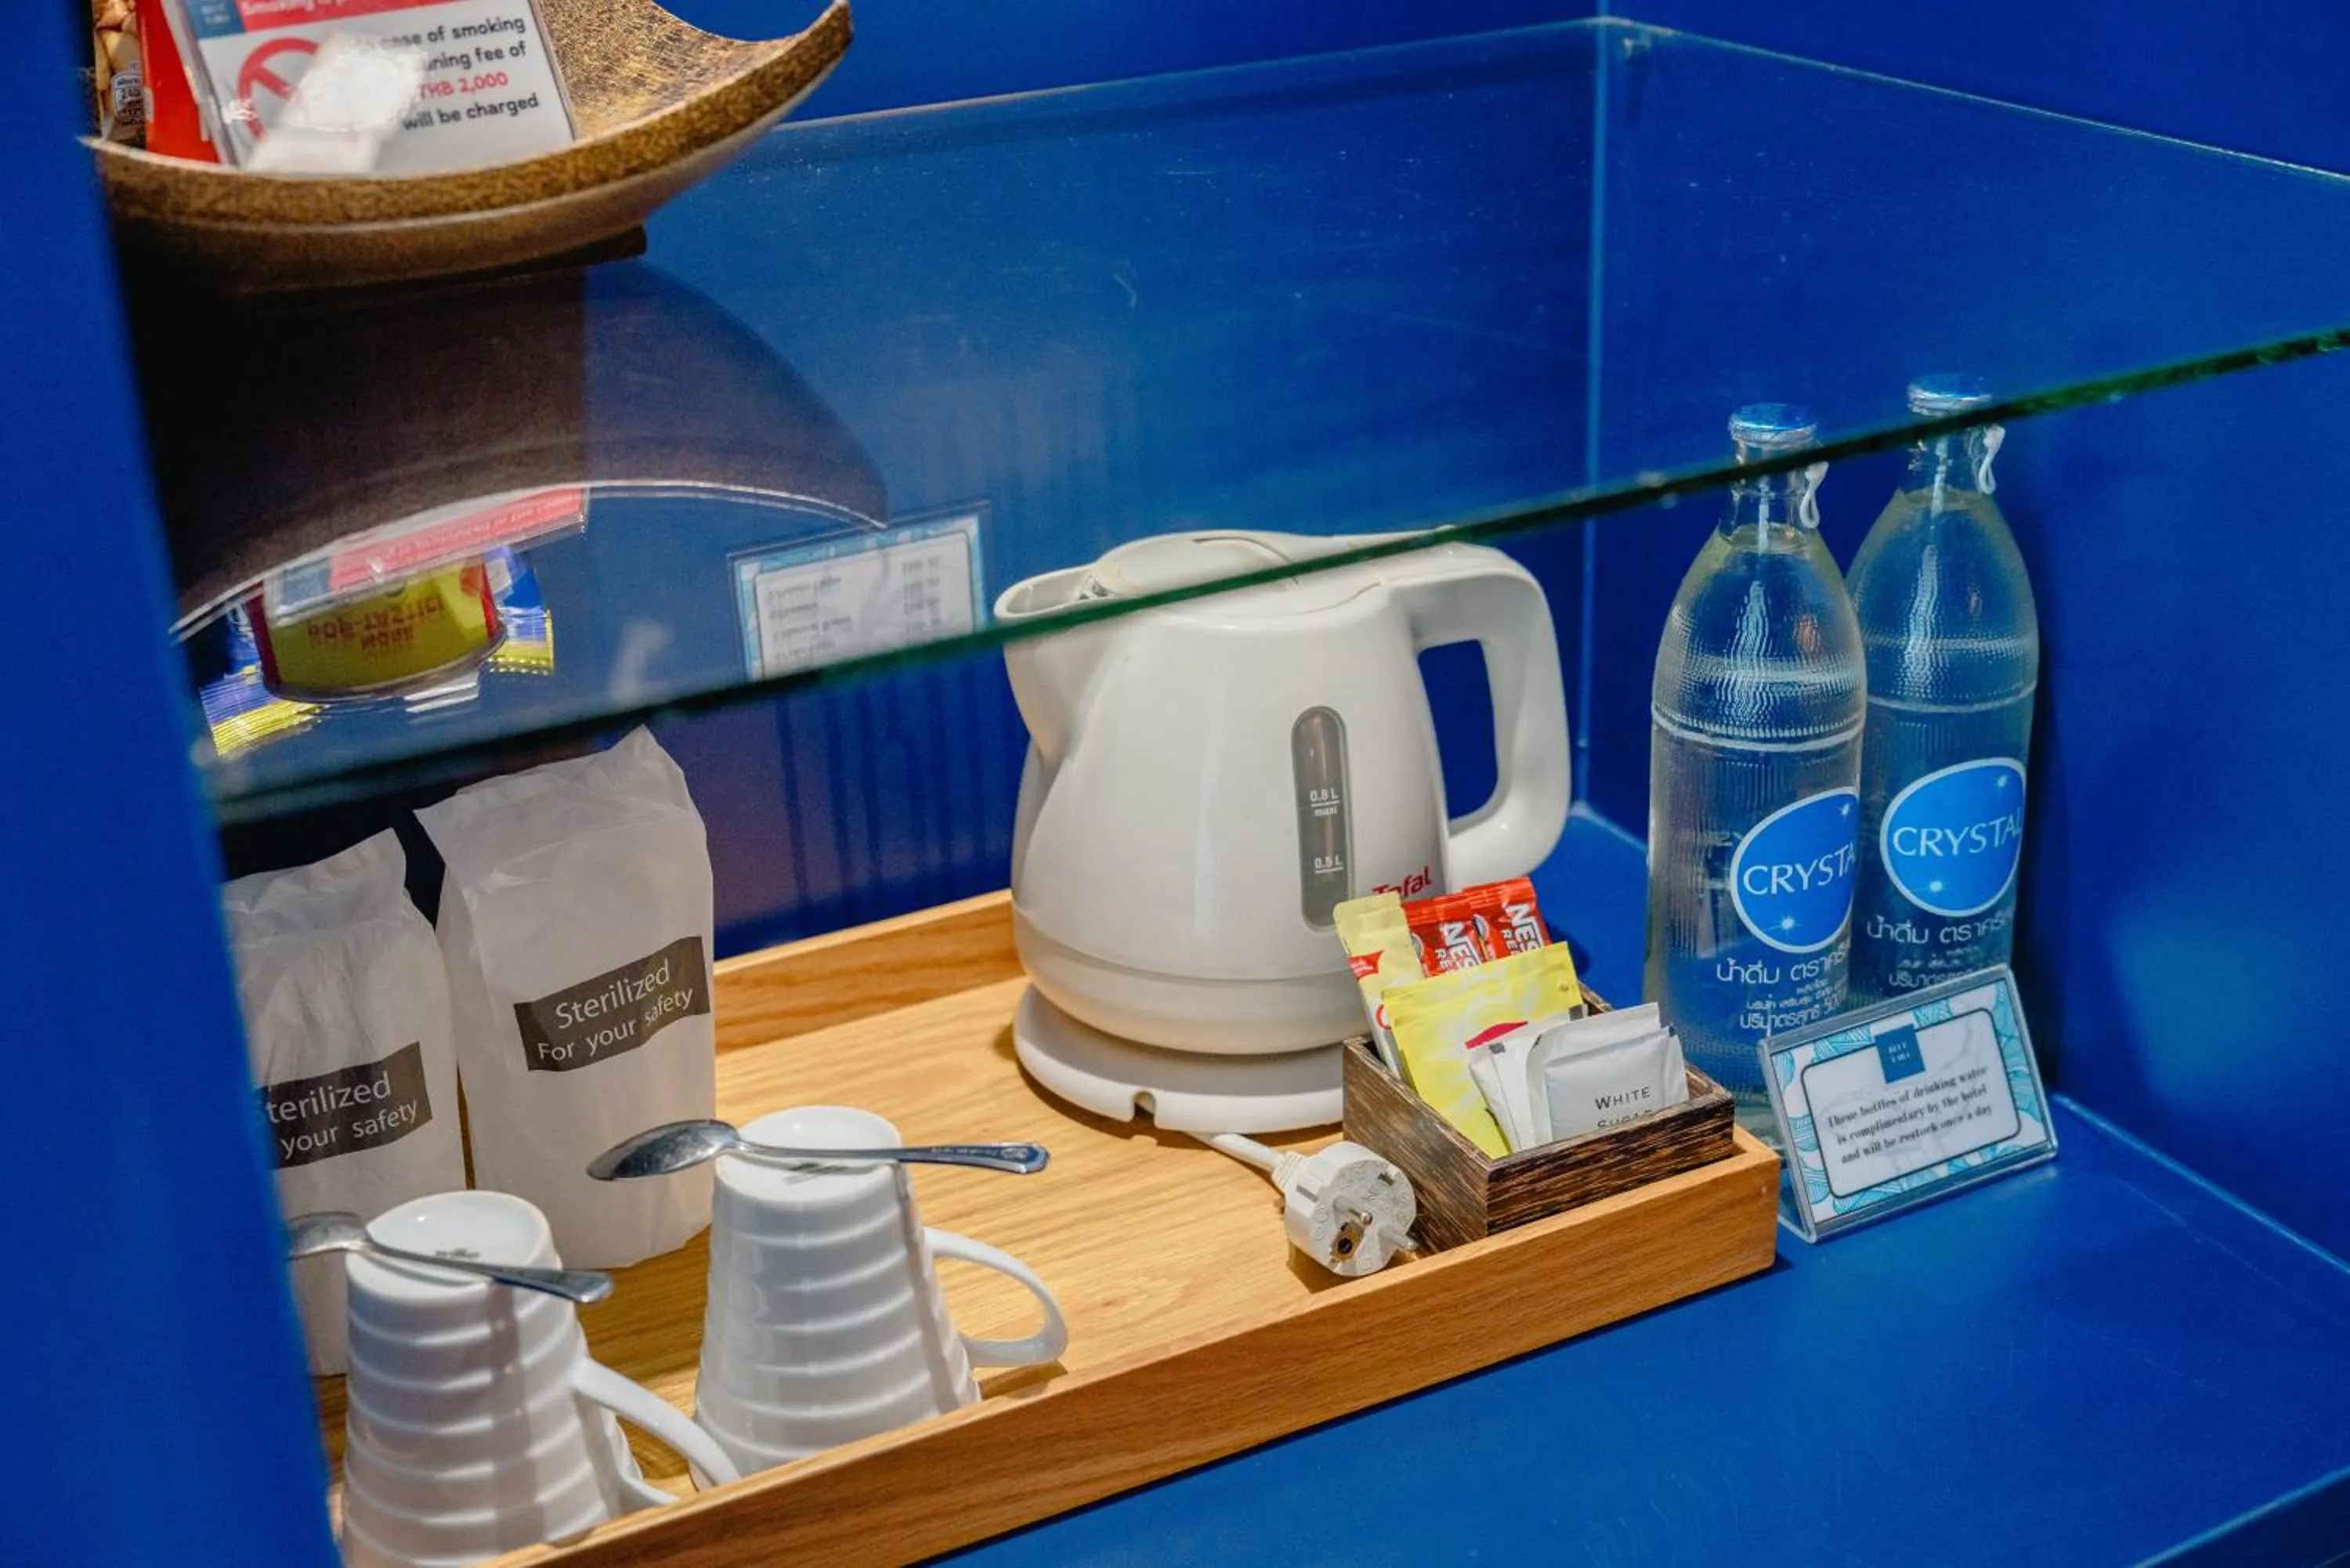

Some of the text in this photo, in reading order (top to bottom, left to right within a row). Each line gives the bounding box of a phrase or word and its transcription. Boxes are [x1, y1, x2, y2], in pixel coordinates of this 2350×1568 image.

[427, 26, 445, 42] of
[452, 16, 526, 39] smoking
[475, 47, 505, 63] fee
[509, 41, 526, 56] of
[402, 92, 539, 130] will be charged
[419, 72, 509, 100] THB 2,000
[1331, 787, 1339, 800] L
[1335, 854, 1343, 865] L
[1743, 840, 1856, 895] CRYSTA
[555, 957, 671, 1029] Sterilized
[537, 988, 694, 1061] For your safety
[266, 1071, 391, 1123] terilized
[1594, 1086, 1651, 1110] WHITE
[1828, 1066, 1987, 1128] These bottles of drinking water
[1836, 1084, 1988, 1144] is complimentary by the hotel
[280, 1100, 418, 1160] your safety
[1842, 1149, 1860, 1164] and
[1863, 1140, 1882, 1157] will
[1884, 1136, 1896, 1149] be
[1900, 1123, 1938, 1143] restock
[1940, 1115, 1964, 1129] once
[1975, 1104, 1992, 1118] day
